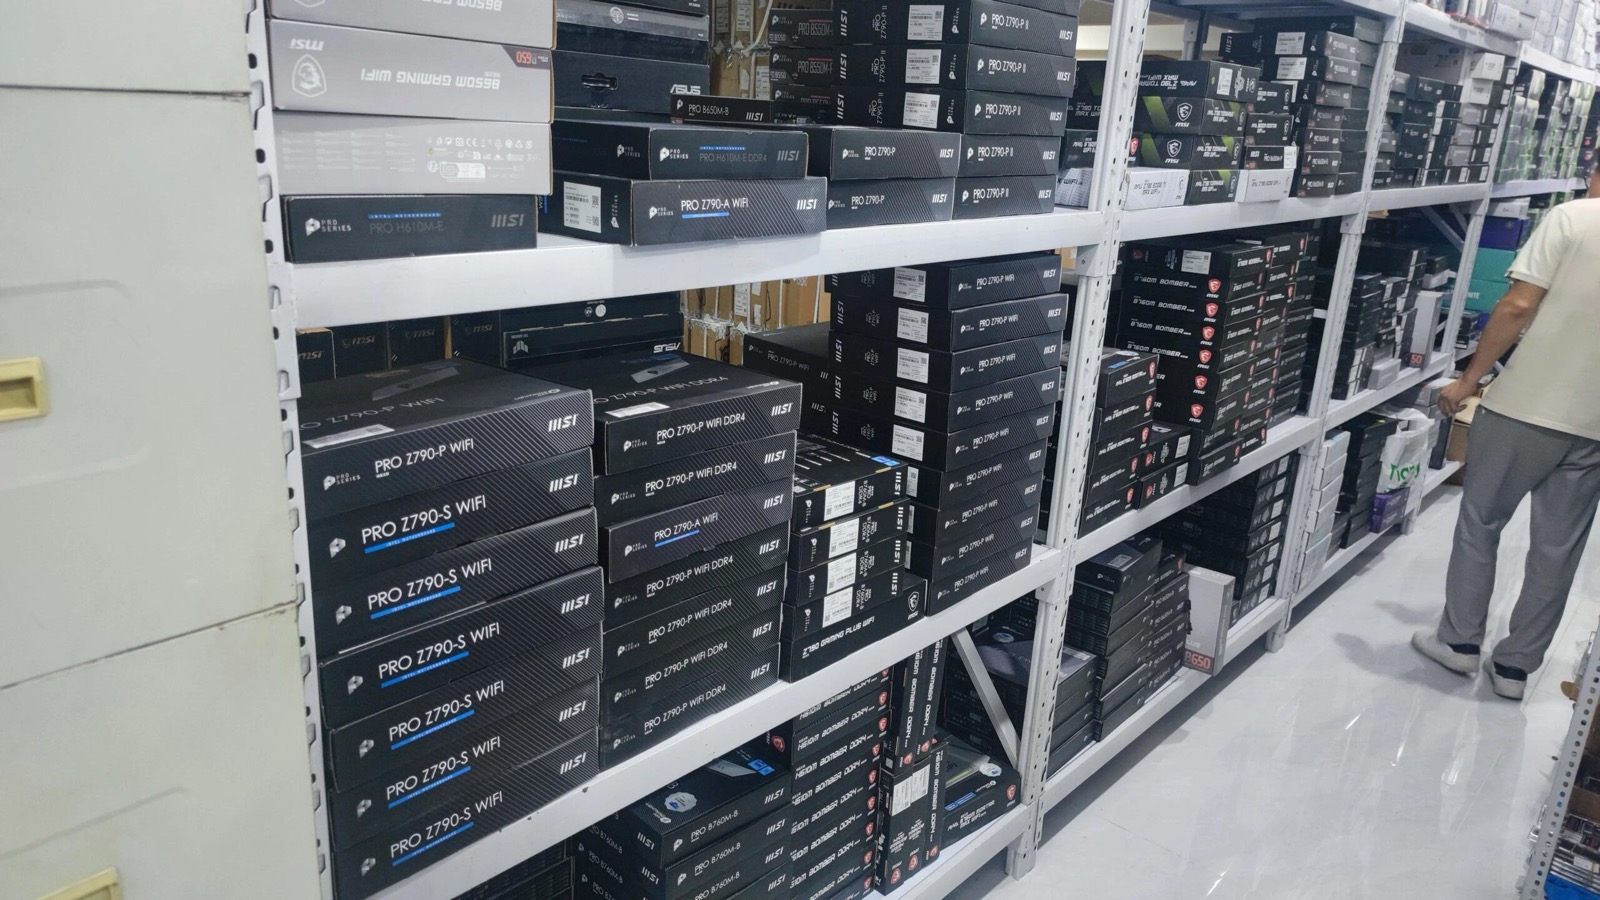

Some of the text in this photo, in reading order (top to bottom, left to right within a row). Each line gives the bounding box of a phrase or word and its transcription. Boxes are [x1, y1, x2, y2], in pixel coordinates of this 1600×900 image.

[991, 14, 1029, 30] PRO Z790-P II
[361, 68, 500, 90] B650M GAMING WIFI
[988, 59, 1026, 73] PRO Z790-P II
[670, 84, 701, 94] ASUS
[689, 104, 729, 115] PRO B650M-B
[985, 104, 1021, 116] PRO Z790-P II
[865, 147, 895, 156] PRO Z790-P
[978, 147, 1013, 157] PRO Z790-P II
[681, 198, 749, 210] PRO Z790-A WIFI
[852, 195, 885, 206] PRO Z790-P
[973, 188, 1009, 199] PRO Z790-P II
[370, 221, 444, 234] PRO H610M-E
[657, 413, 745, 440] PRO Z790-P WIFI DDR4
[375, 438, 474, 473] PRO Z790-P WIFI
[646, 462, 737, 492] PRO Z790-P WIFI DDR4
[362, 494, 486, 544] PRO Z790-S WIFI
[655, 512, 718, 541] PRO Z790-A WIFI
[368, 558, 492, 610] PRO Z790-S WIFI
[647, 556, 733, 594] PRO Z790-P WIFI DDR4
[649, 599, 732, 641] PRO Z790-P WIFI DDR4
[379, 622, 500, 679] PRO Z790-S WIFI
[803, 617, 874, 656] Z790 GAMING PLUS WIFI
[645, 642, 728, 685] PRO Z790-P WIFI DDR4
[389, 680, 504, 741] PRO Z790-S WIFI
[644, 684, 726, 731] PRO Z790-P WIFI DDR4
[387, 736, 501, 800] PRO Z790-S WIFI
[390, 791, 503, 858] PRO Z790-S WIFI
[691, 810, 739, 841] PRO B760M-B
[695, 842, 741, 874] PRO B760M-B
